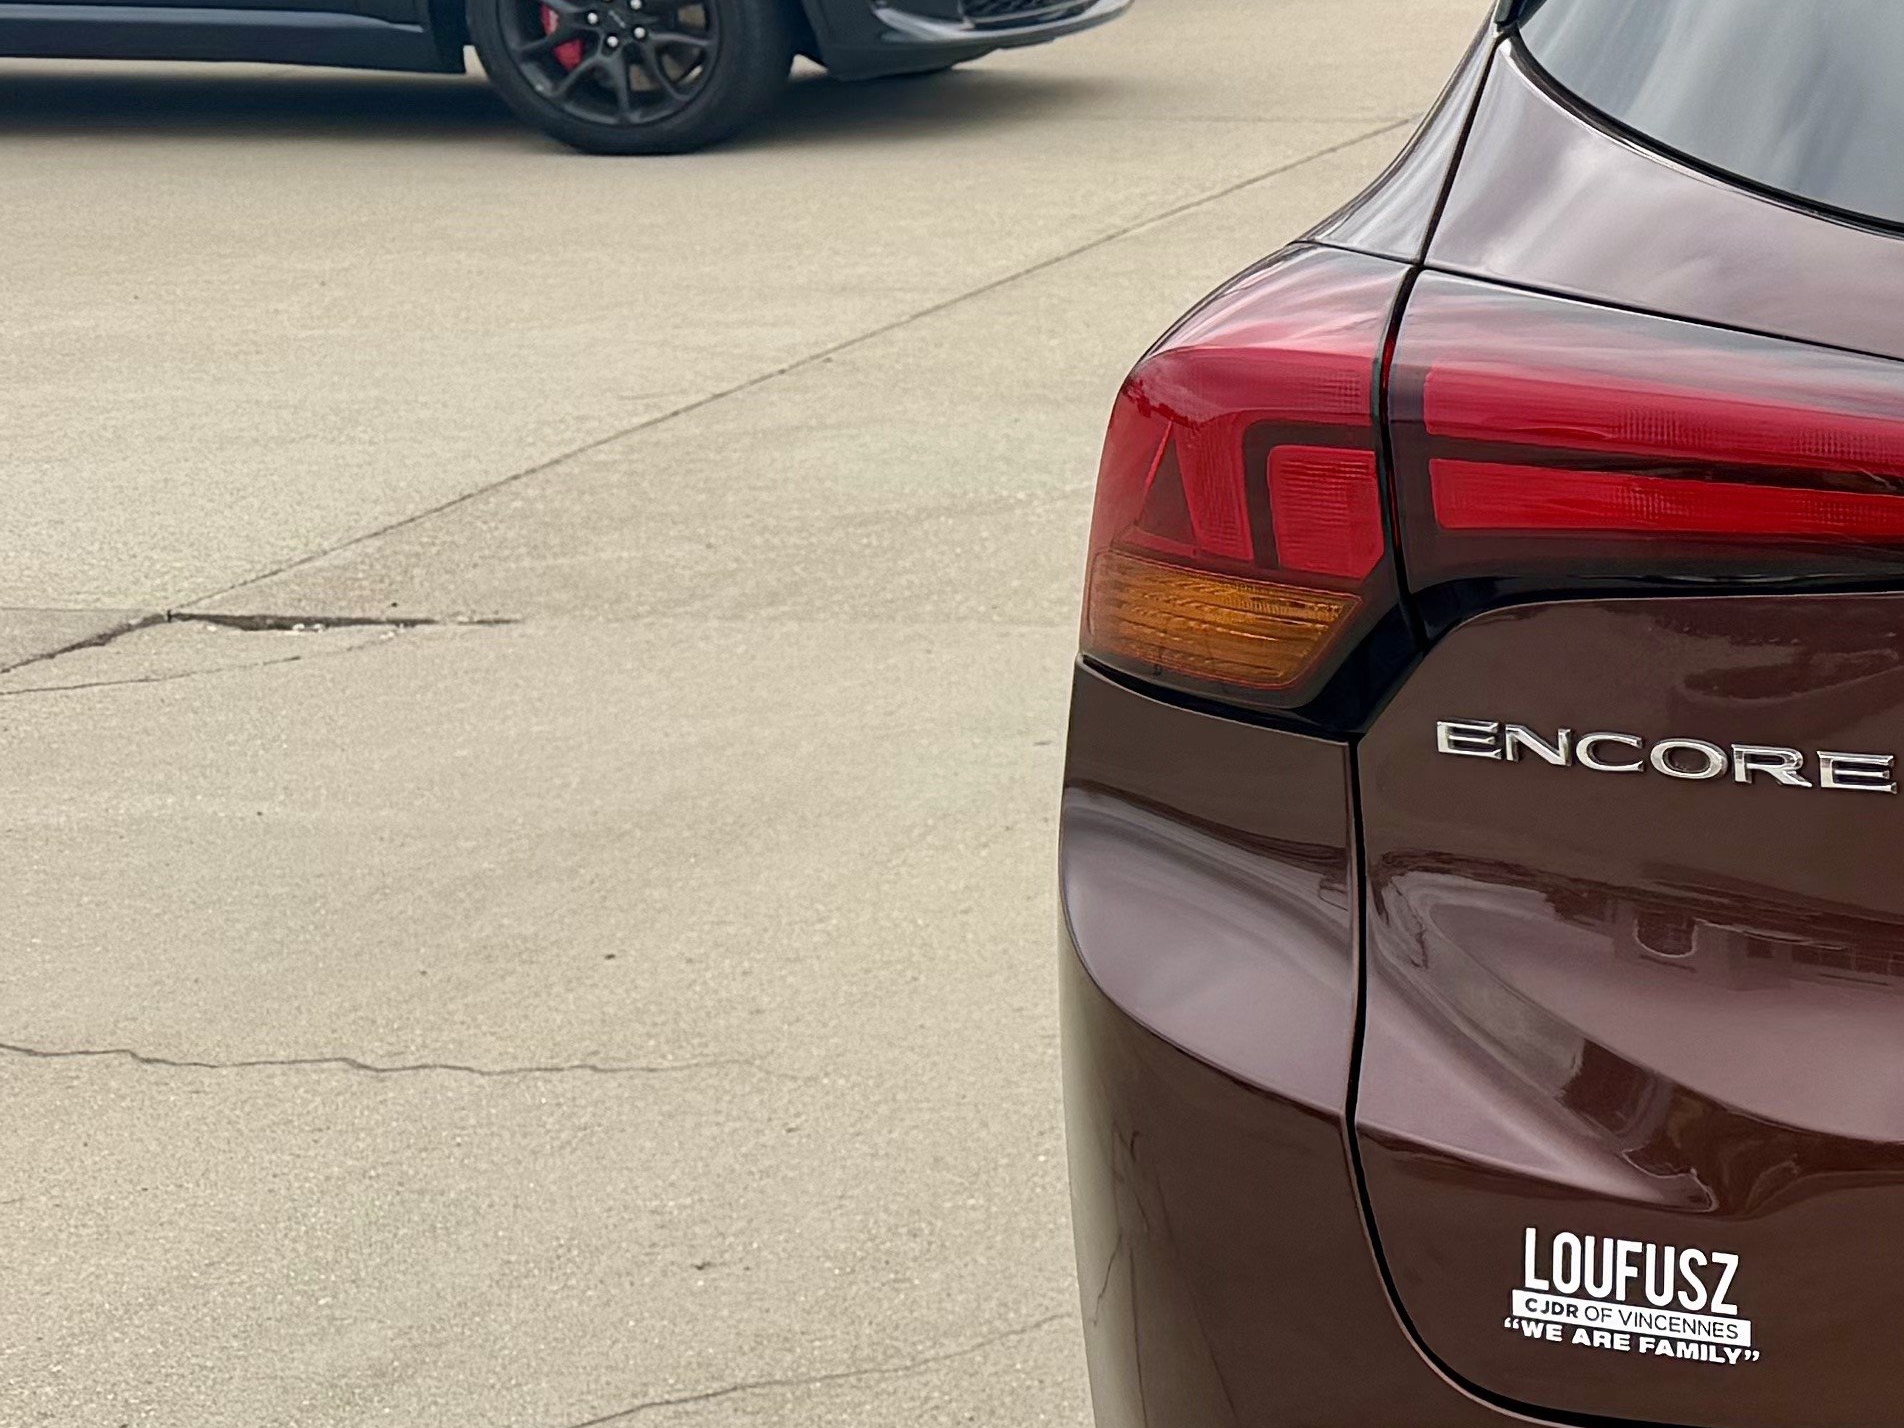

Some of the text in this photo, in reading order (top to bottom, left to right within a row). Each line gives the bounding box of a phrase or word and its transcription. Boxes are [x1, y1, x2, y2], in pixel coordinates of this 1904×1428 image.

[1436, 718, 1898, 795] ENCORE
[1503, 1316, 1760, 1365] “WE ARE FAMILY”
[1525, 1297, 1739, 1340] CJDR OF VINCENNES
